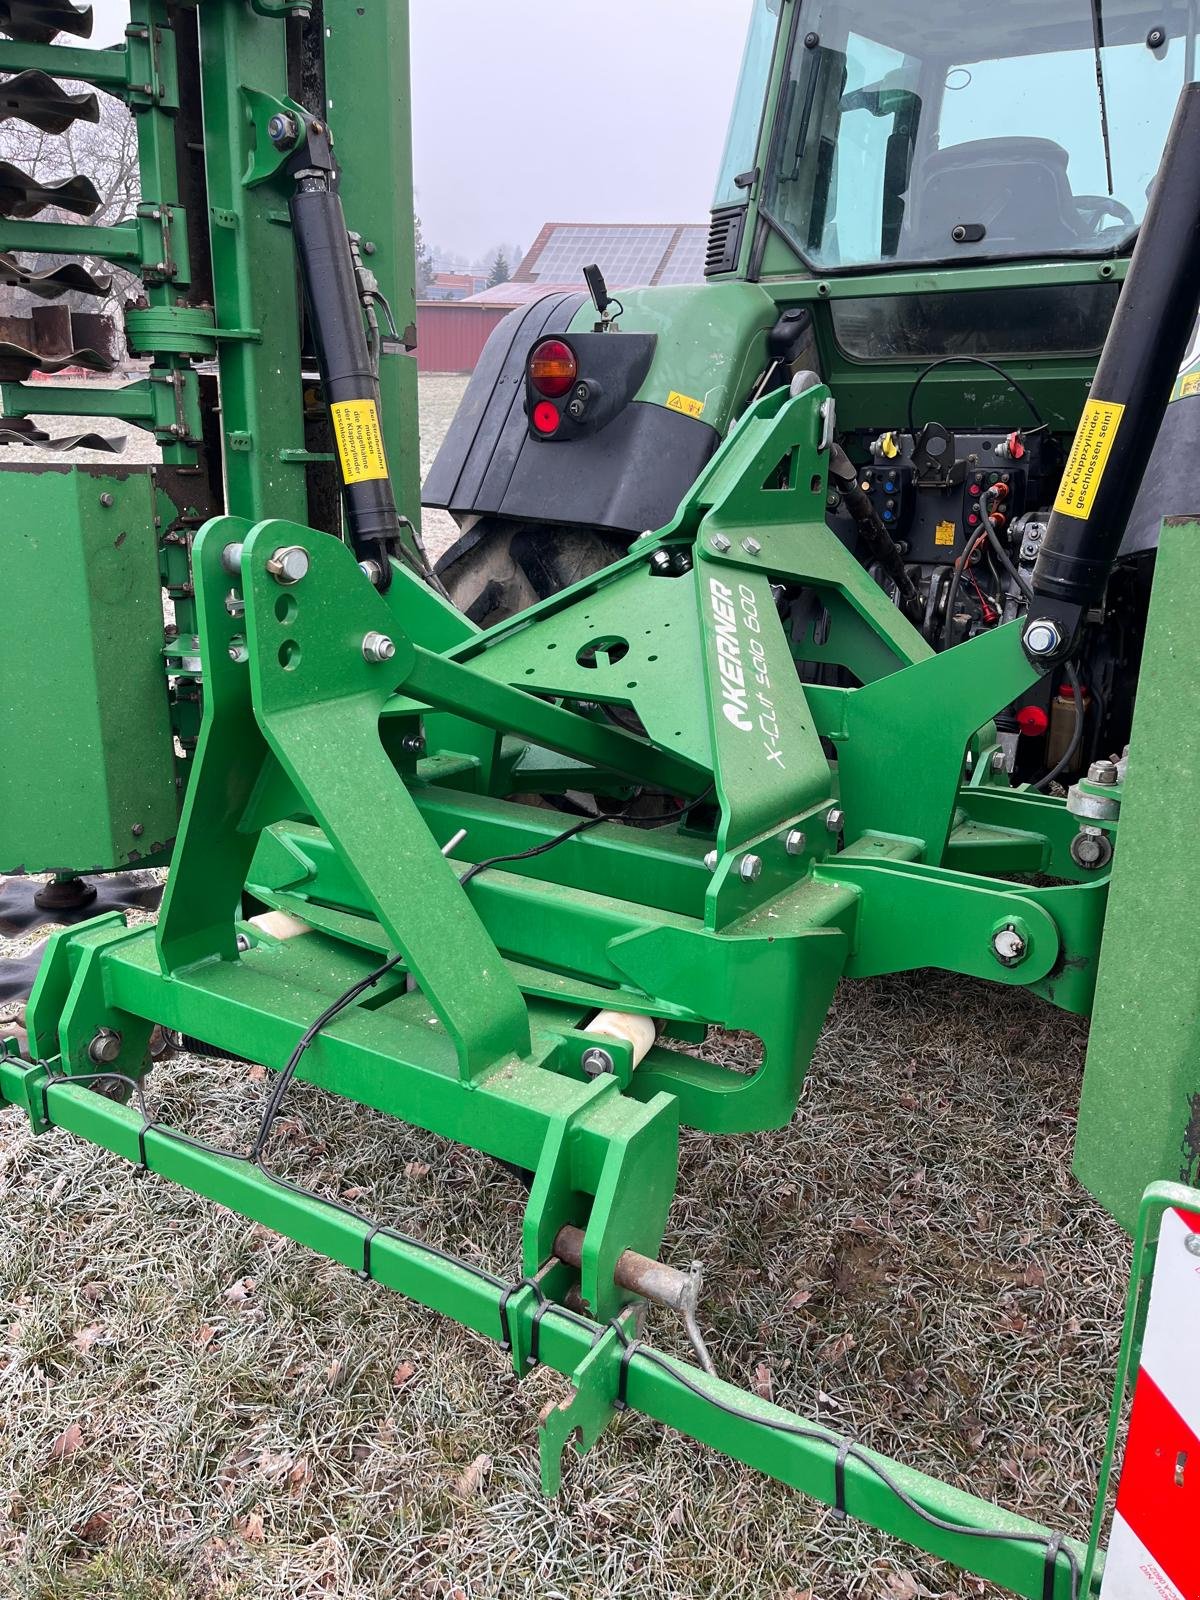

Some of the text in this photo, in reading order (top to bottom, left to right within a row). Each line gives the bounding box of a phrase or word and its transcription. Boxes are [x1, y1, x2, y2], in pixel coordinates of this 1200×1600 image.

[335, 408, 354, 477] geschlossen sein!
[353, 411, 361, 423] die
[364, 424, 375, 455] müssen
[346, 423, 361, 475] Klappzylinder
[1066, 410, 1100, 505] der Klappzylinder
[1076, 411, 1112, 509] geschlossen sein!
[738, 583, 761, 634] 600
[710, 577, 749, 711] KERNER
[1139, 1565, 1154, 1580] DIN
